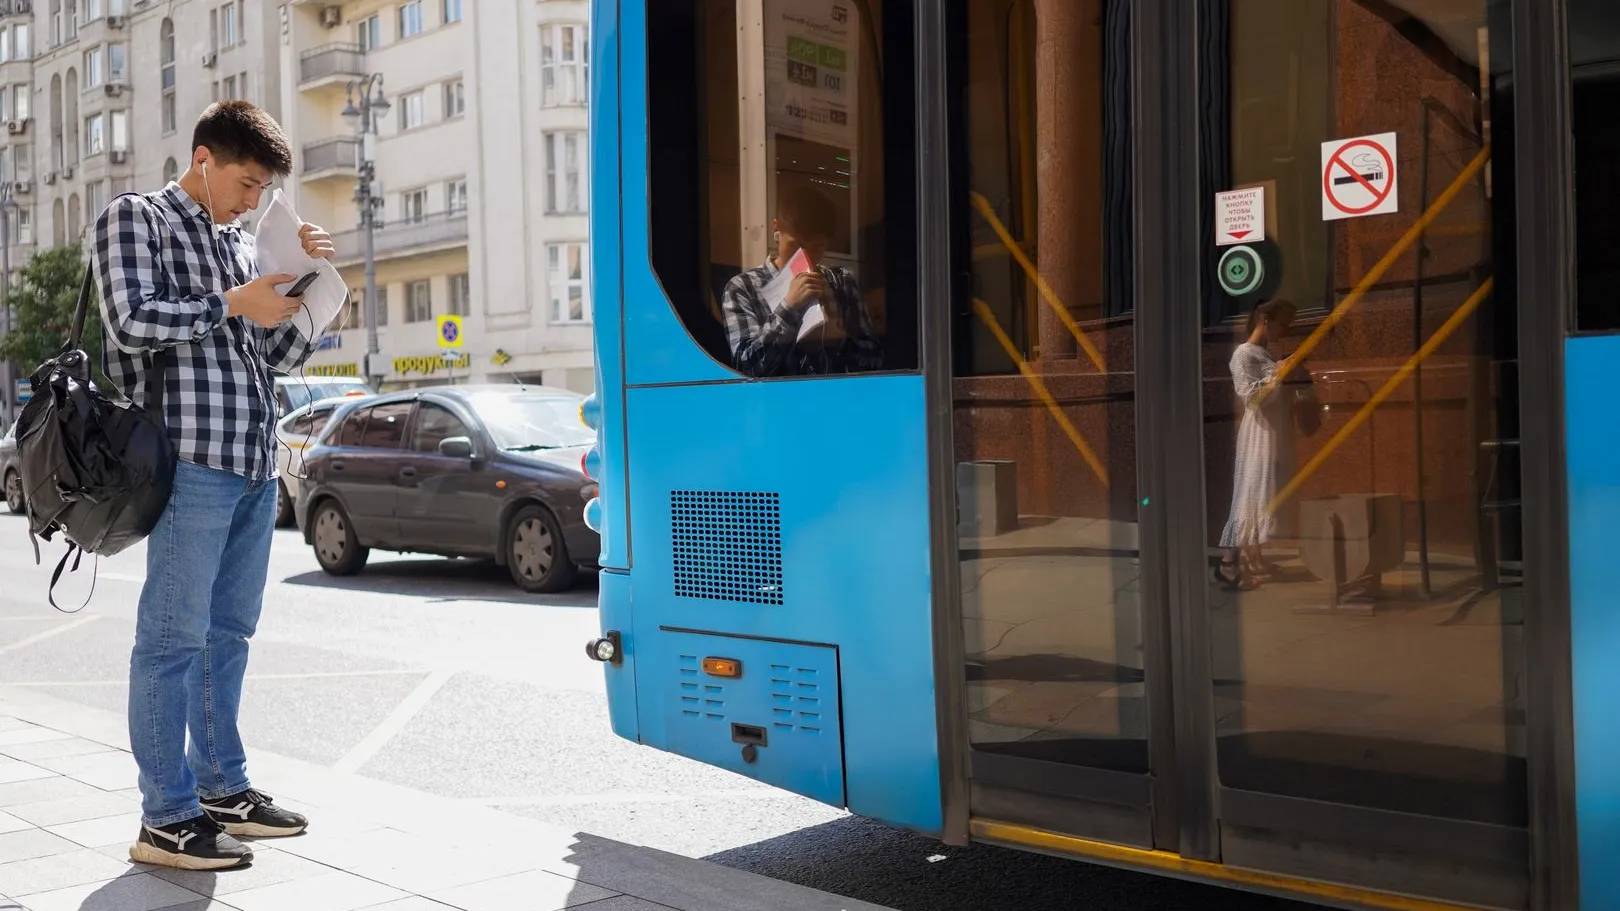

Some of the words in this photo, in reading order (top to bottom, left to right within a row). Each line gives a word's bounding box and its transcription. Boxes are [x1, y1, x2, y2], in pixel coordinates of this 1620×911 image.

[1222, 192, 1256, 200] НАЖМИТЕ
[1225, 200, 1253, 208] КНОПКУ
[1228, 207, 1251, 215] ЧТОБЫ
[1224, 214, 1255, 223] ОТКРЫТЬ
[1229, 223, 1250, 231] ДВЕРЬ
